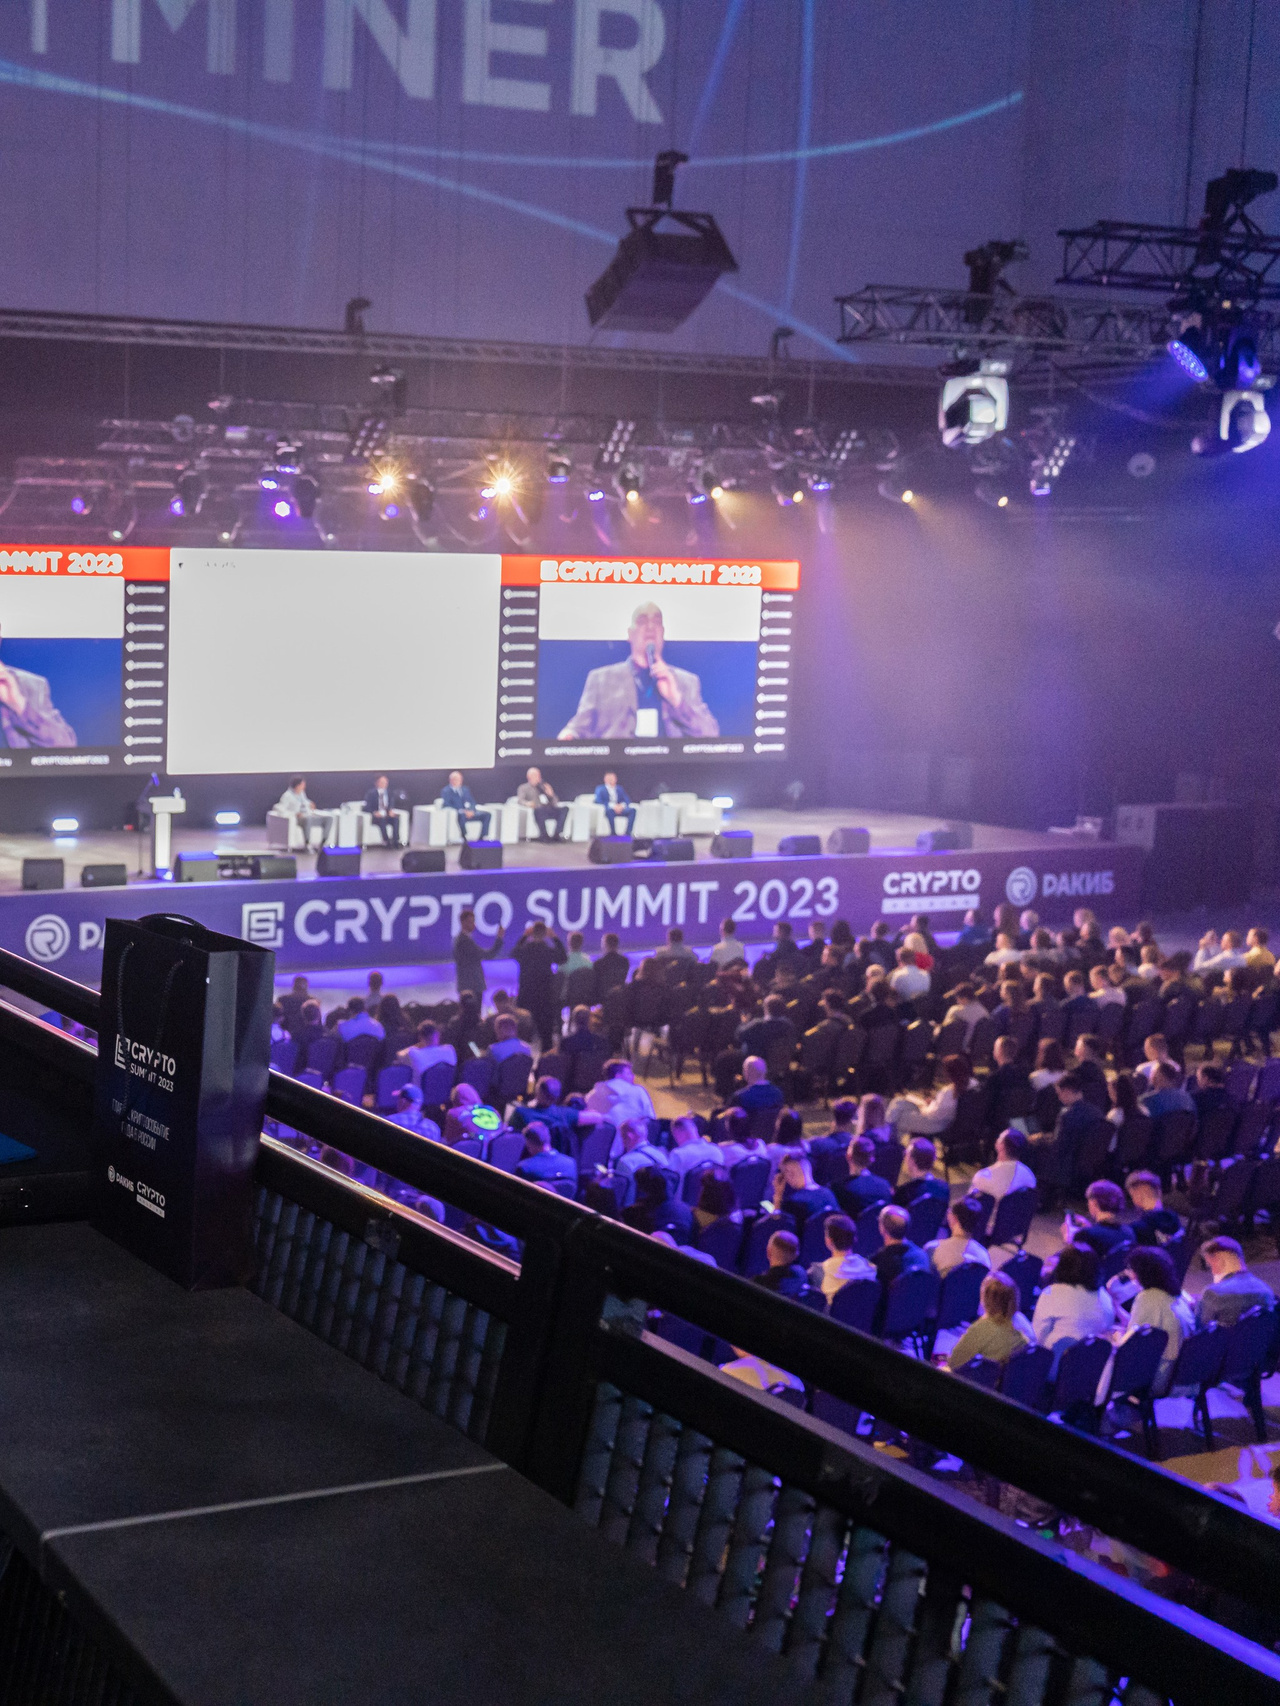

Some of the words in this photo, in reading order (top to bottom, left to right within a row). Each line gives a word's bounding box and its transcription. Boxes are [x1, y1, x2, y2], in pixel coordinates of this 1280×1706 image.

[67, 552, 124, 574] 2023
[558, 561, 640, 582] CRYPTO
[640, 563, 716, 584] SUMMIT
[717, 564, 762, 585] 2023
[883, 869, 981, 895] CRYPTO
[294, 891, 513, 946] CRYPTO
[526, 880, 719, 932] SUMMIT
[731, 876, 840, 922] 2023
[131, 1042, 176, 1076] CRYPTO
[158, 1076, 174, 1092] 2023
[137, 1181, 165, 1207] CRYPTO
